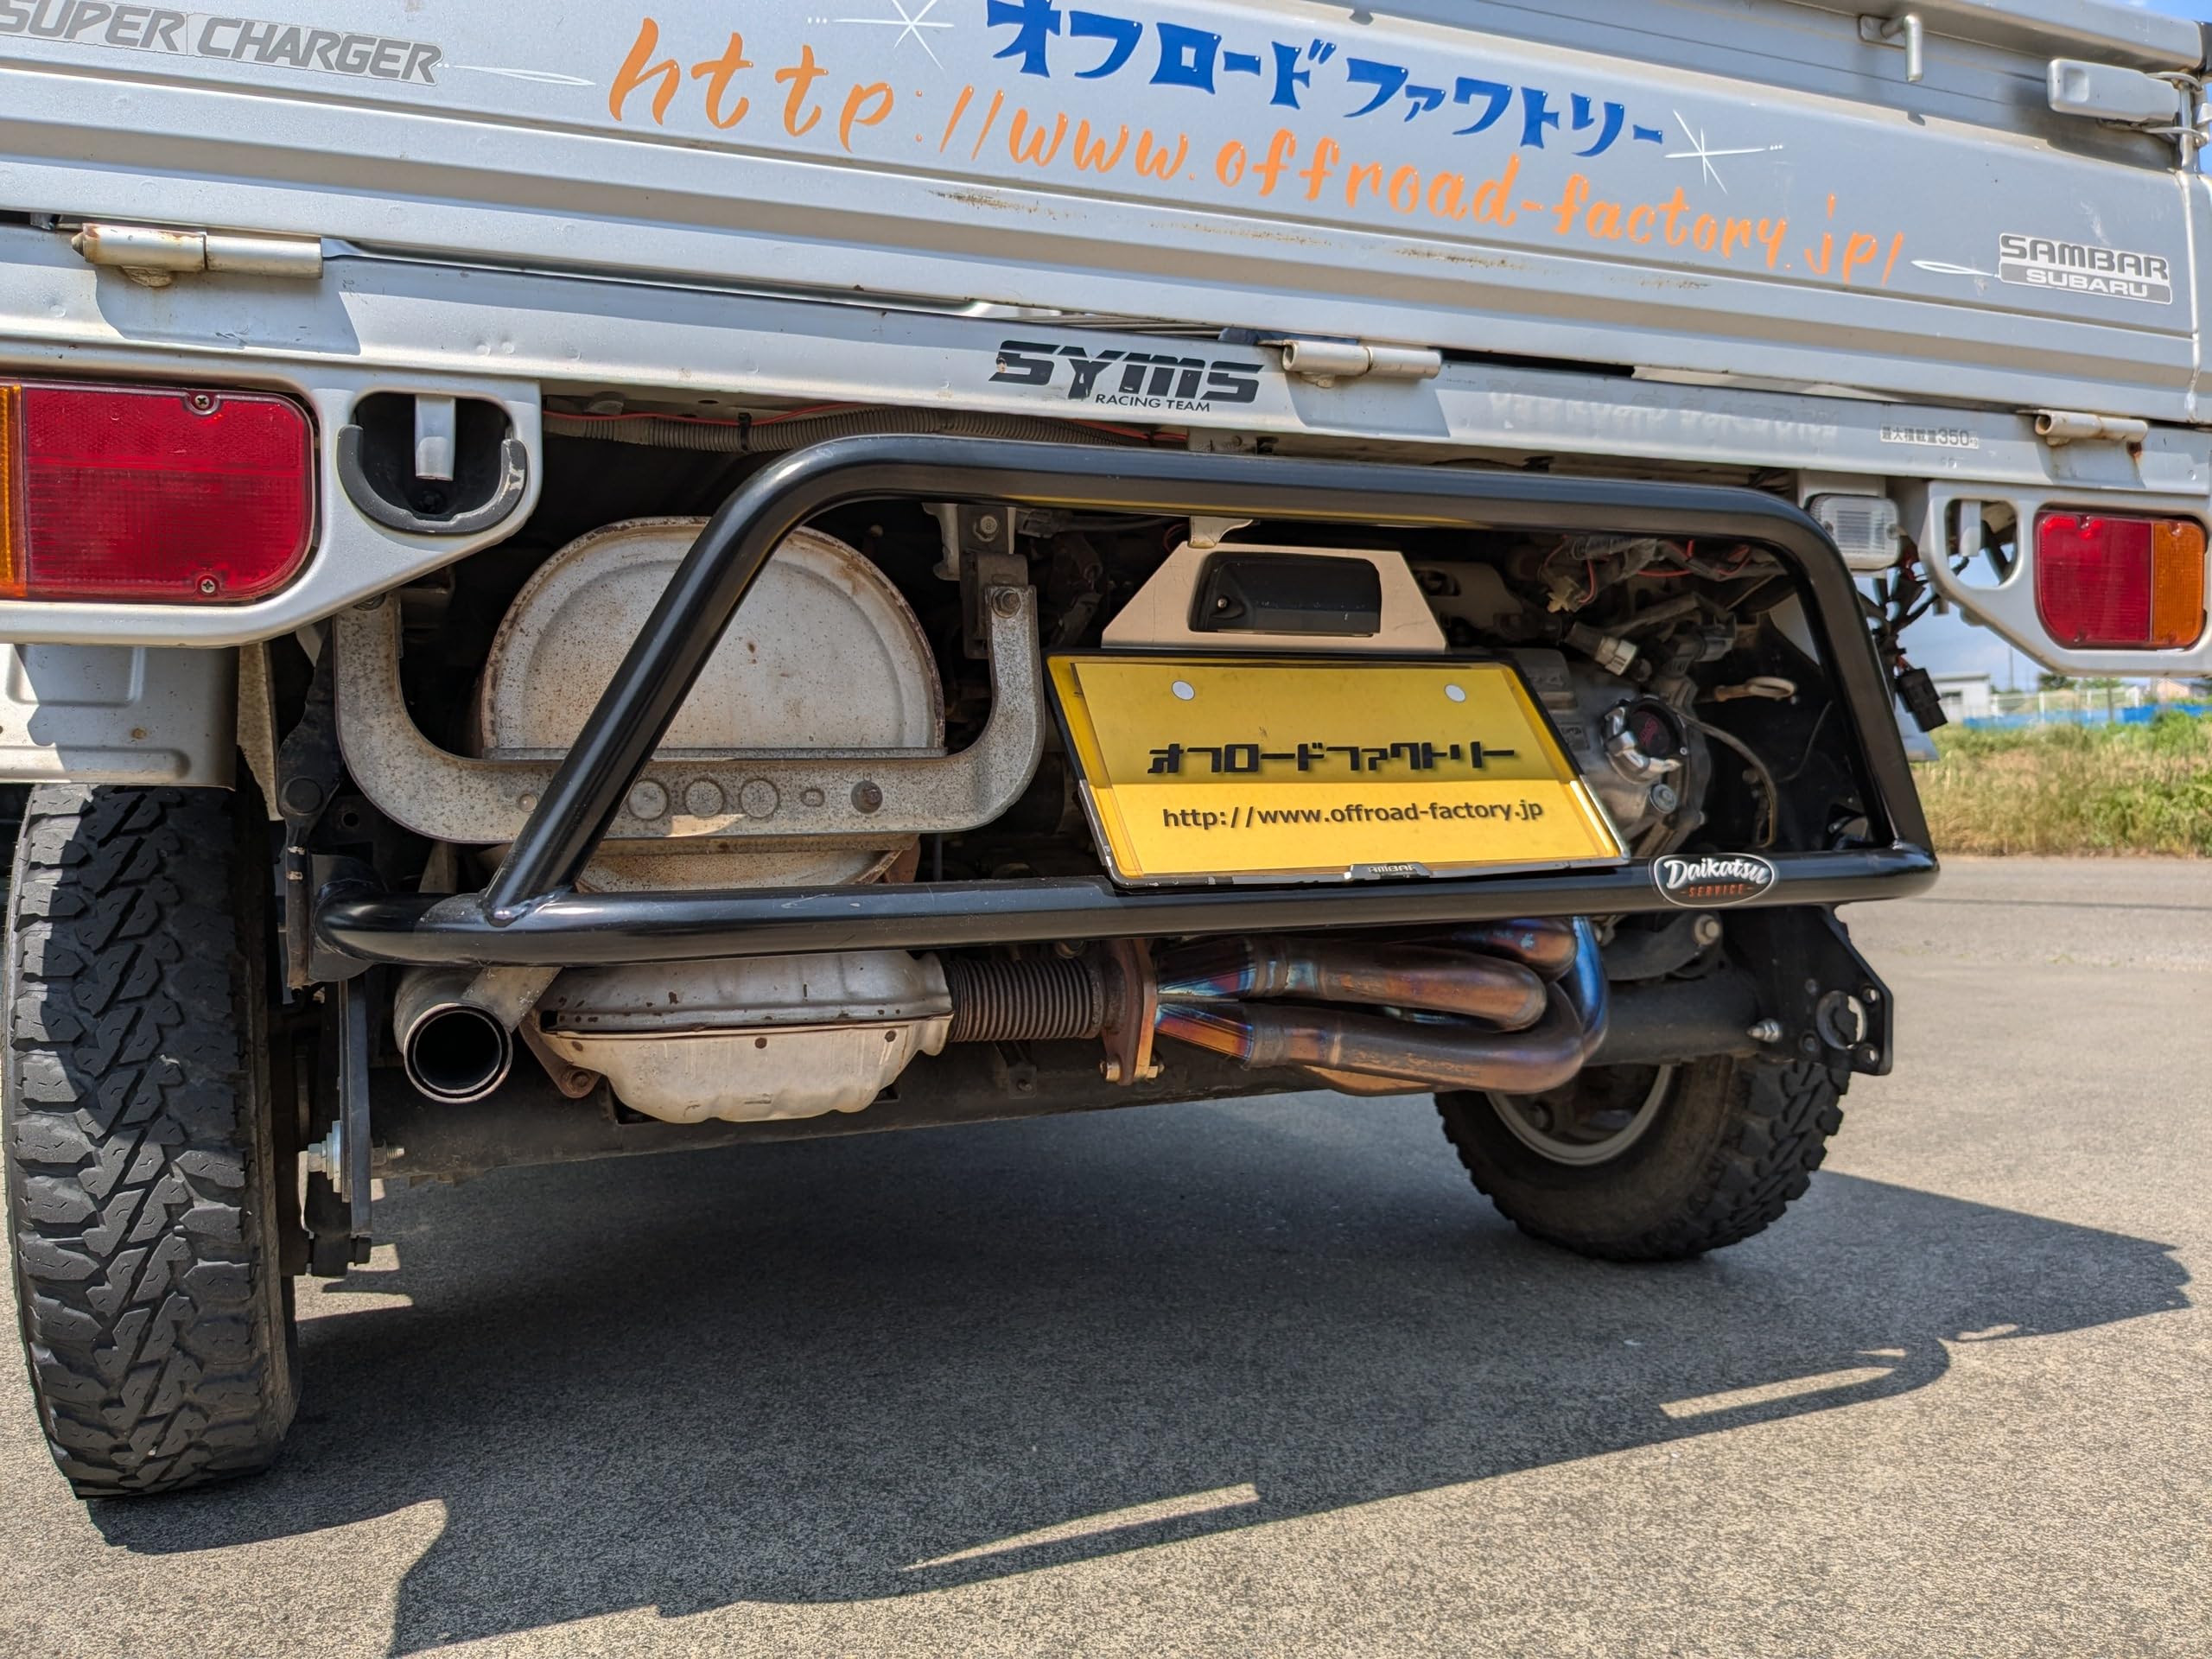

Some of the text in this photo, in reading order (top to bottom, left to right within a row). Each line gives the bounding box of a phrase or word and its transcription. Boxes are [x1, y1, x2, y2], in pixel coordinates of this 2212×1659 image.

[0, 0, 442, 84] SUPER CHARGER
[2000, 234, 2170, 281] SAMBAR
[2026, 268, 2148, 297] SUBARU
[1095, 393, 1211, 412] RACING TEAM
[1147, 741, 1515, 774] オフロードファクトリー
[1162, 800, 1544, 830] http://www.offroad-factory.jp
[1663, 857, 1770, 889] Daikatsu
[1688, 884, 1745, 899] SERVICE
